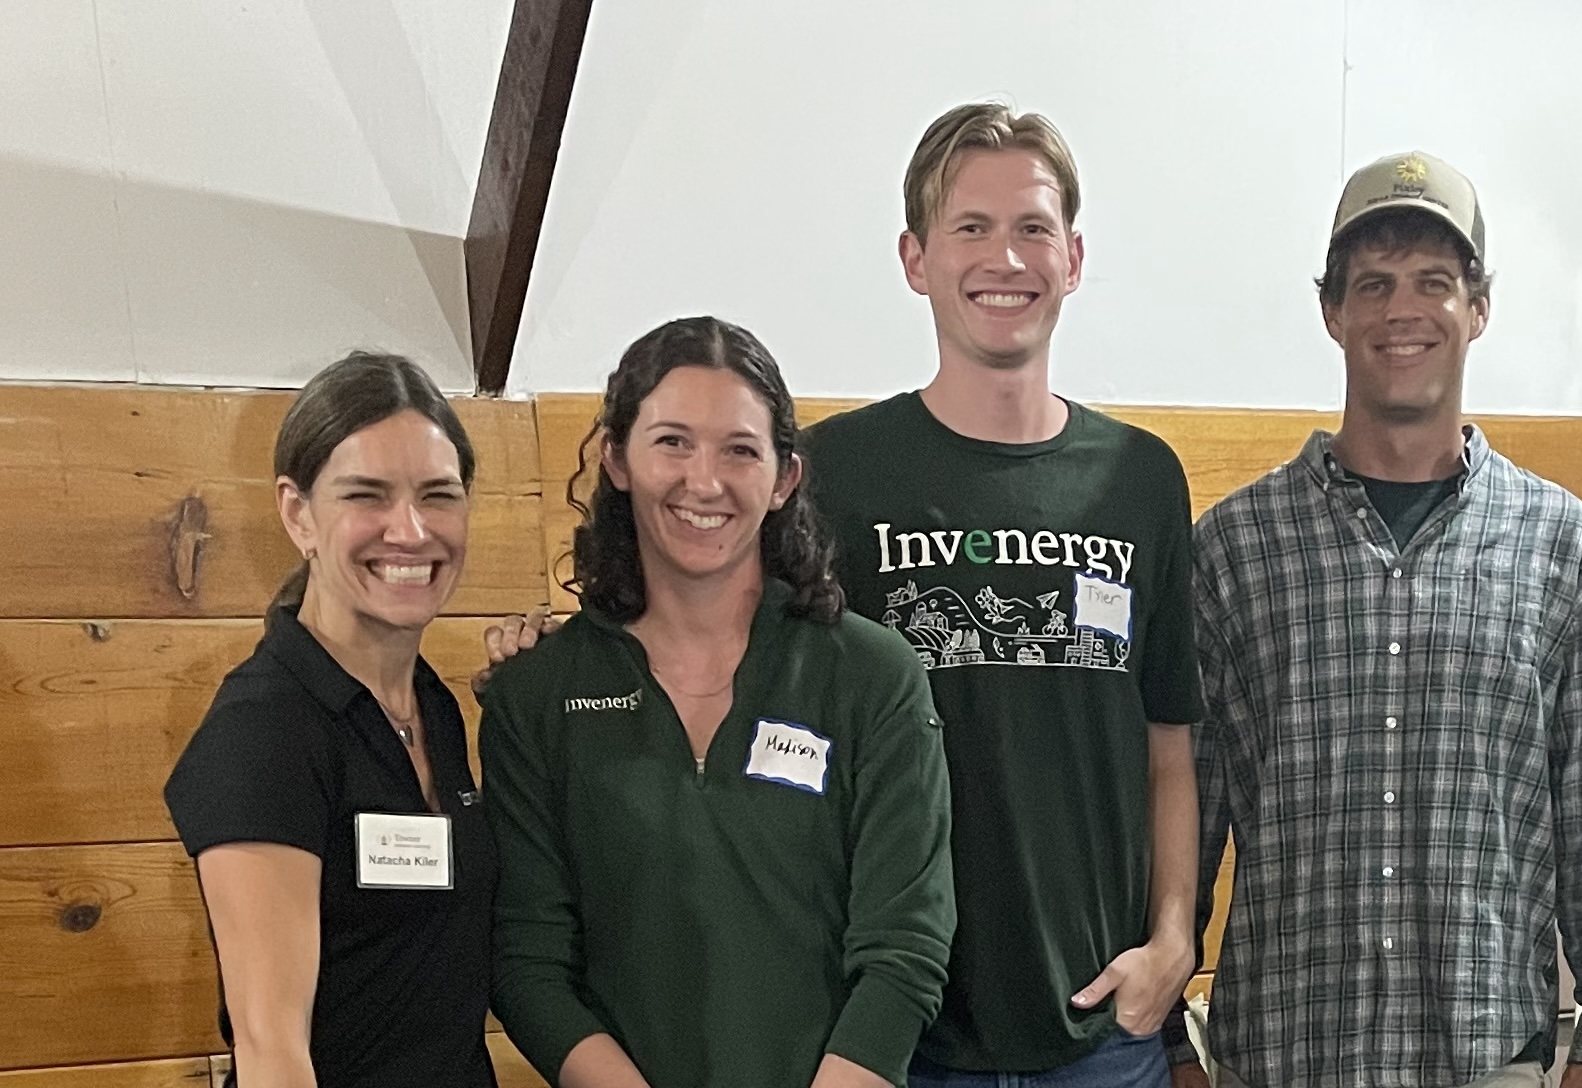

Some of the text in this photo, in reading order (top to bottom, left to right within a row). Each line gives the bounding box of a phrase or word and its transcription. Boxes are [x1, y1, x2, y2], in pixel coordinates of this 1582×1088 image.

[873, 523, 1135, 584] Invenergy
[765, 735, 819, 760] Madison
[368, 855, 411, 866] Natacha
